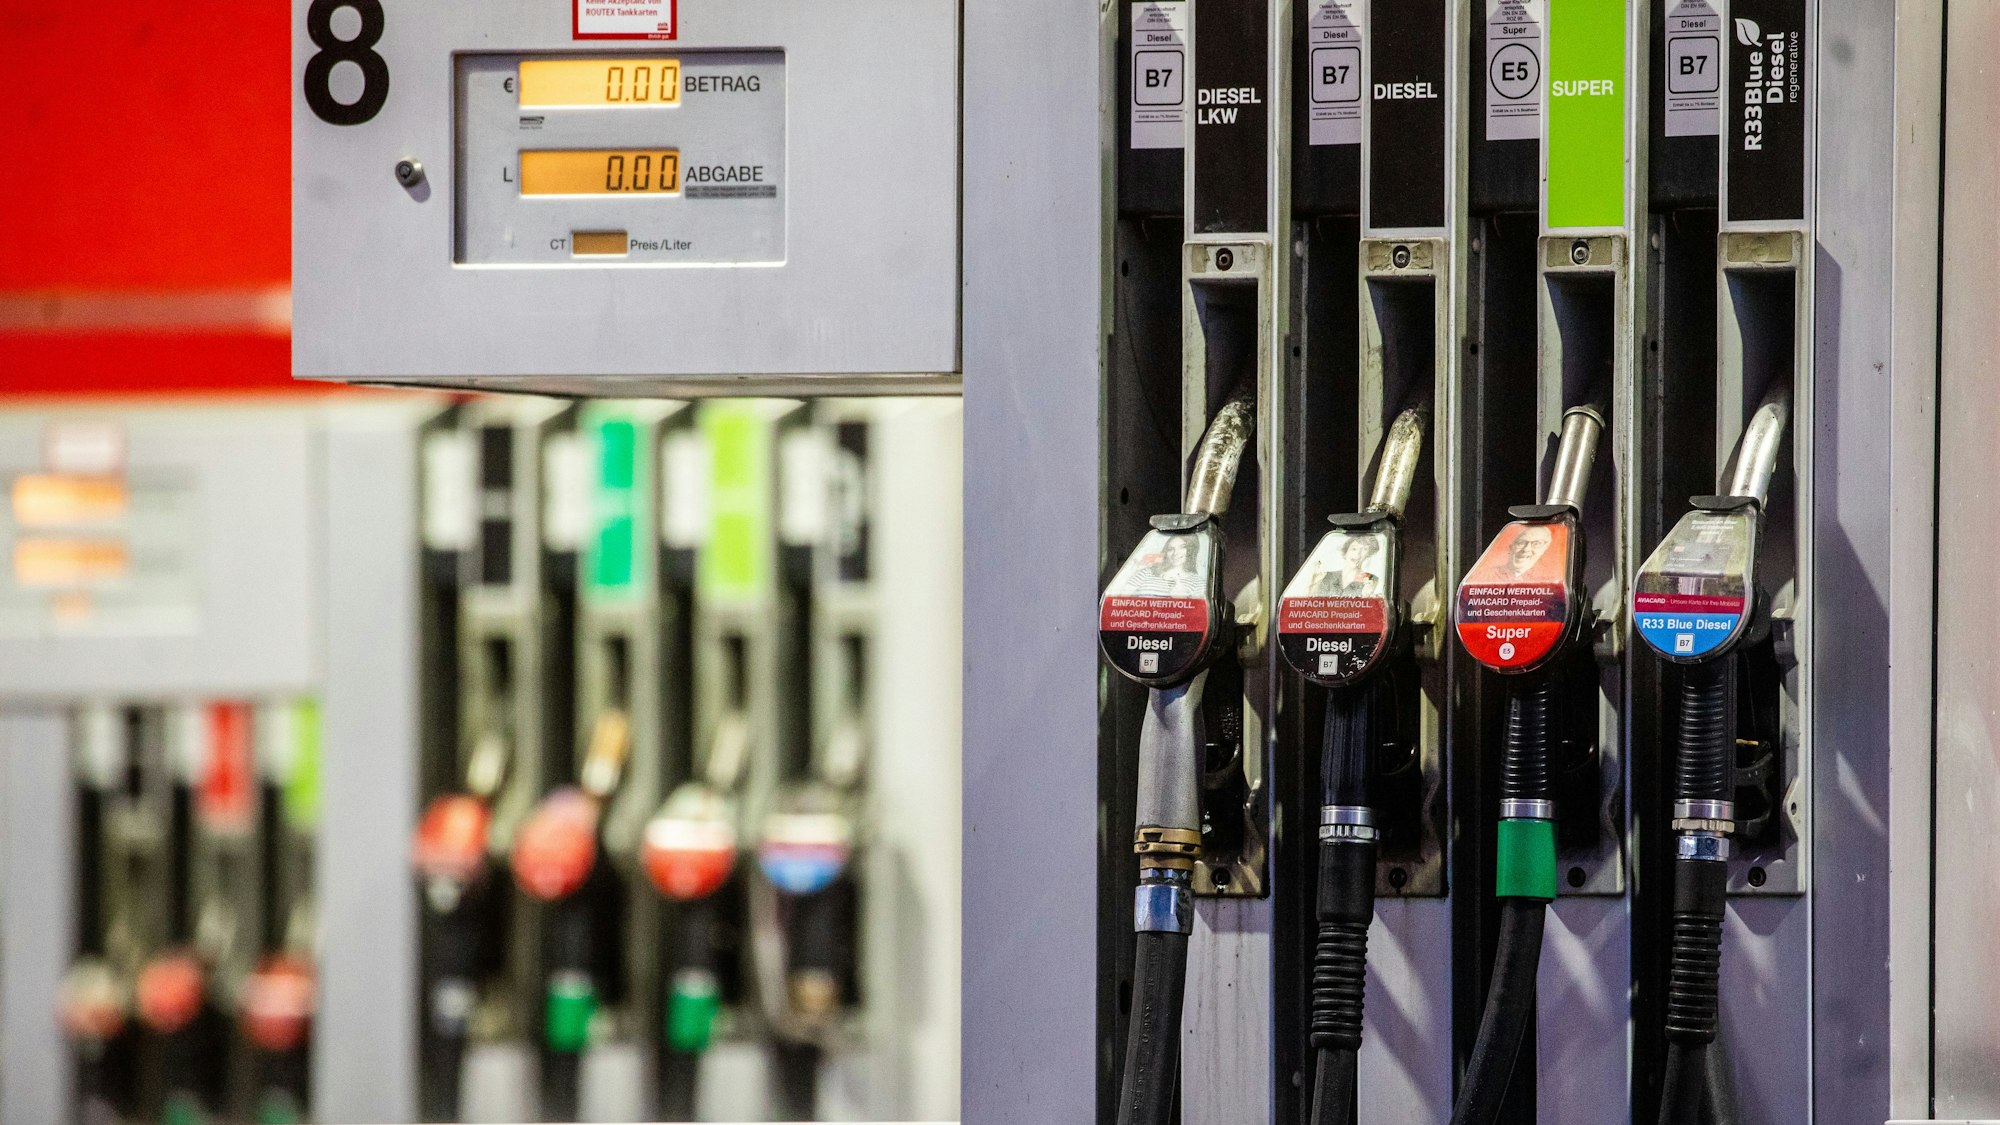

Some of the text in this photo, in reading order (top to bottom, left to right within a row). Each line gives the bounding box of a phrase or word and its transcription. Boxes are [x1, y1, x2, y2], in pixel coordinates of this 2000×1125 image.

[586, 8, 658, 16] ROUTEX Tankkarten
[1502, 26, 1527, 35] Super
[1681, 20, 1706, 28] Diesel
[1146, 34, 1172, 42] Diesel
[1323, 31, 1348, 39] Diesel
[304, 0, 389, 126] 8
[1680, 56, 1708, 75] B7
[1766, 32, 1785, 104] Diesel
[1788, 31, 1800, 104] regenerative
[1146, 69, 1172, 88] B7
[1322, 66, 1350, 84] B7
[1502, 62, 1528, 81] E5
[503, 78, 514, 93] €
[606, 66, 678, 102] 0.00
[684, 76, 760, 92] BETRAG
[1374, 82, 1438, 100] DIESEL
[1552, 80, 1614, 97] SUPER
[1198, 88, 1262, 104] DIESEL
[1198, 108, 1238, 124] LKW
[503, 167, 513, 182] L
[606, 156, 678, 190] 0.00
[685, 166, 764, 182] ABGABE
[550, 239, 566, 250] CT
[630, 239, 658, 250] Preis
[1468, 588, 1554, 596] EINFACH WERTVOLL.
[1112, 598, 1196, 609] EINFACH WERTVOLL.
[1468, 598, 1543, 608] AVIACARD Prepaid-
[1110, 610, 1184, 620] AVIACARD Prepaid-
[1331, 611, 1363, 620] Prepaid-
[1467, 608, 1546, 616] und Geschenkkarten
[1126, 621, 1187, 630] Geschenkkarten
[1304, 622, 1366, 630] Geschenkkarten
[1642, 618, 1731, 630] R33 Blue Diesel
[1486, 625, 1531, 642] Super
[1127, 635, 1174, 651] Diesel
[1306, 638, 1352, 652] Diesel
